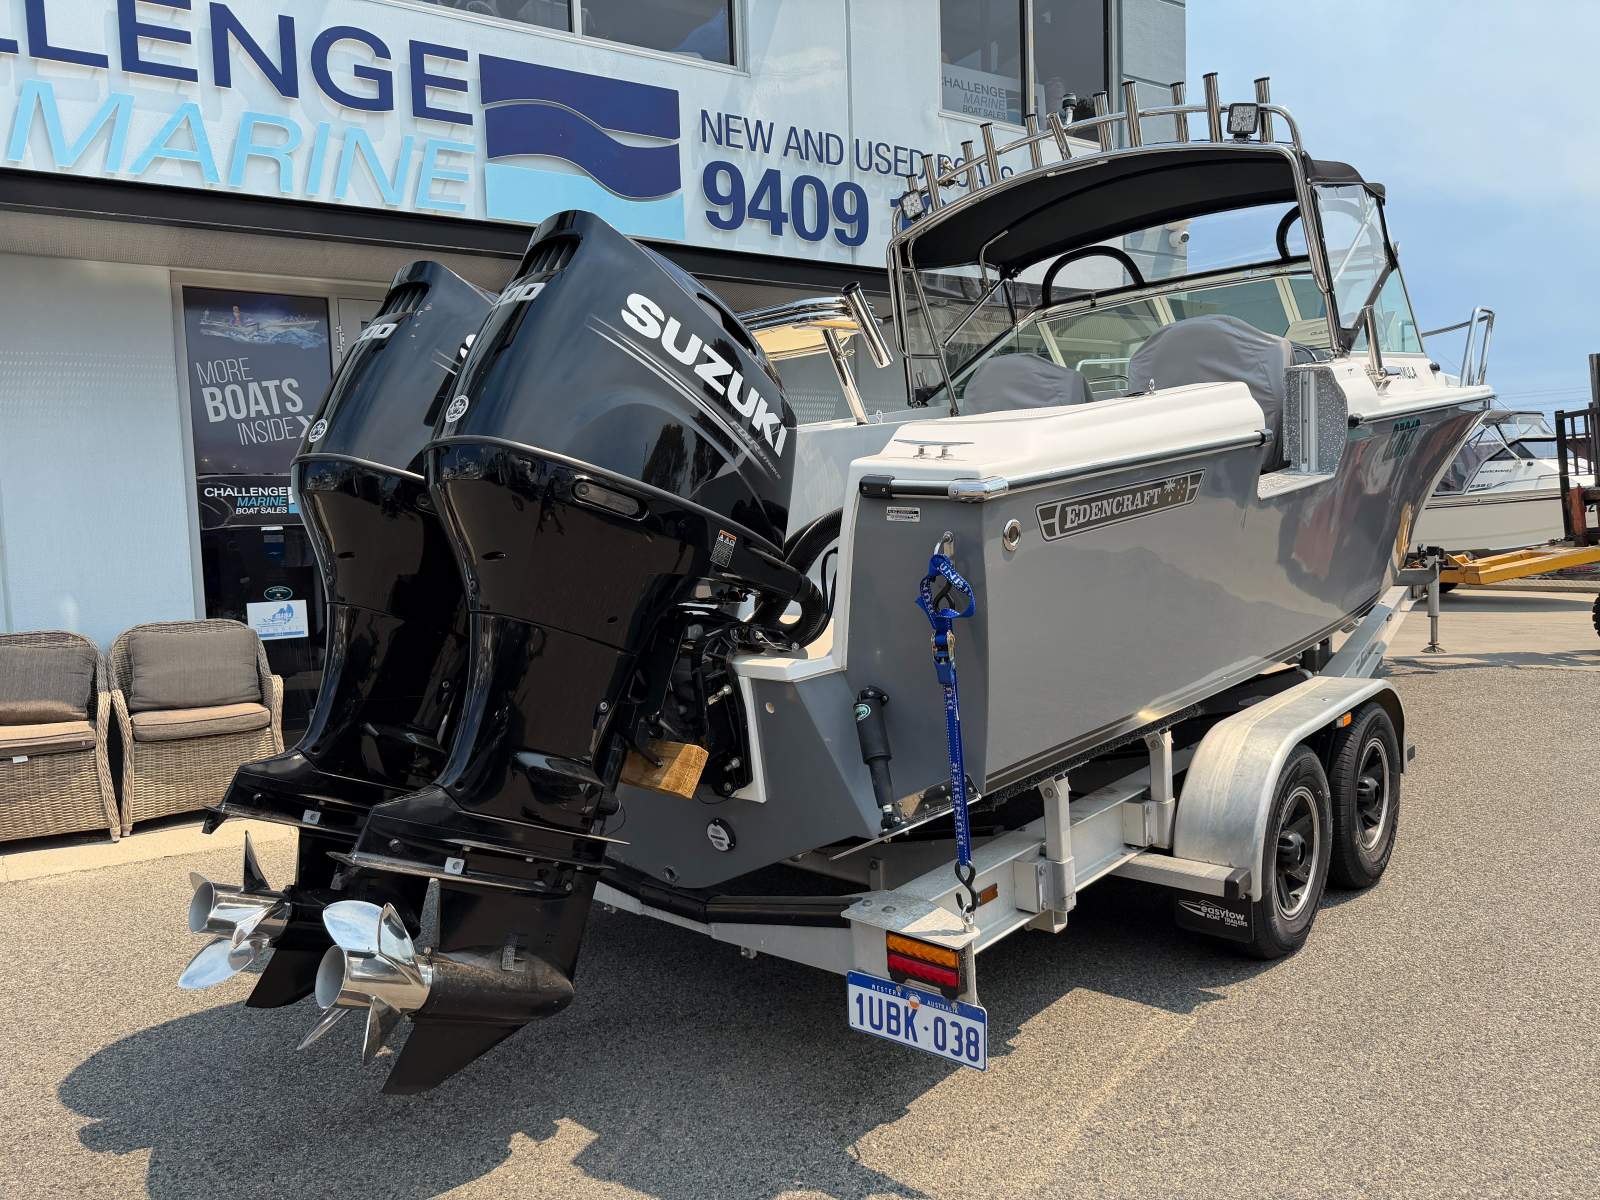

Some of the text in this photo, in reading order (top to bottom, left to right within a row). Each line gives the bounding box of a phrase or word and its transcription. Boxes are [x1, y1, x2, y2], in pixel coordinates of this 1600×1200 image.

[0, 0, 474, 126] LENGE
[962, 104, 1007, 120] BOAT SALES
[963, 92, 1007, 111] MARINE
[7, 79, 477, 212] MARINE
[700, 108, 774, 155] NEW
[784, 127, 844, 167] AND
[855, 139, 926, 180] USED
[702, 160, 869, 247] 9409
[196, 357, 253, 385] MORE
[620, 292, 788, 458] SUZUKI
[201, 378, 303, 423] BOATS
[237, 417, 297, 446] INSIDE
[204, 486, 287, 497] CHALLENGE
[236, 496, 287, 507] MARINE
[235, 506, 288, 515] BOAT SALES
[1064, 488, 1162, 530] EDENCRAFT
[1200, 906, 1245, 921] easytow
[1224, 917, 1248, 927] TRAILERS
[926, 999, 959, 1015] AUSTRALIA
